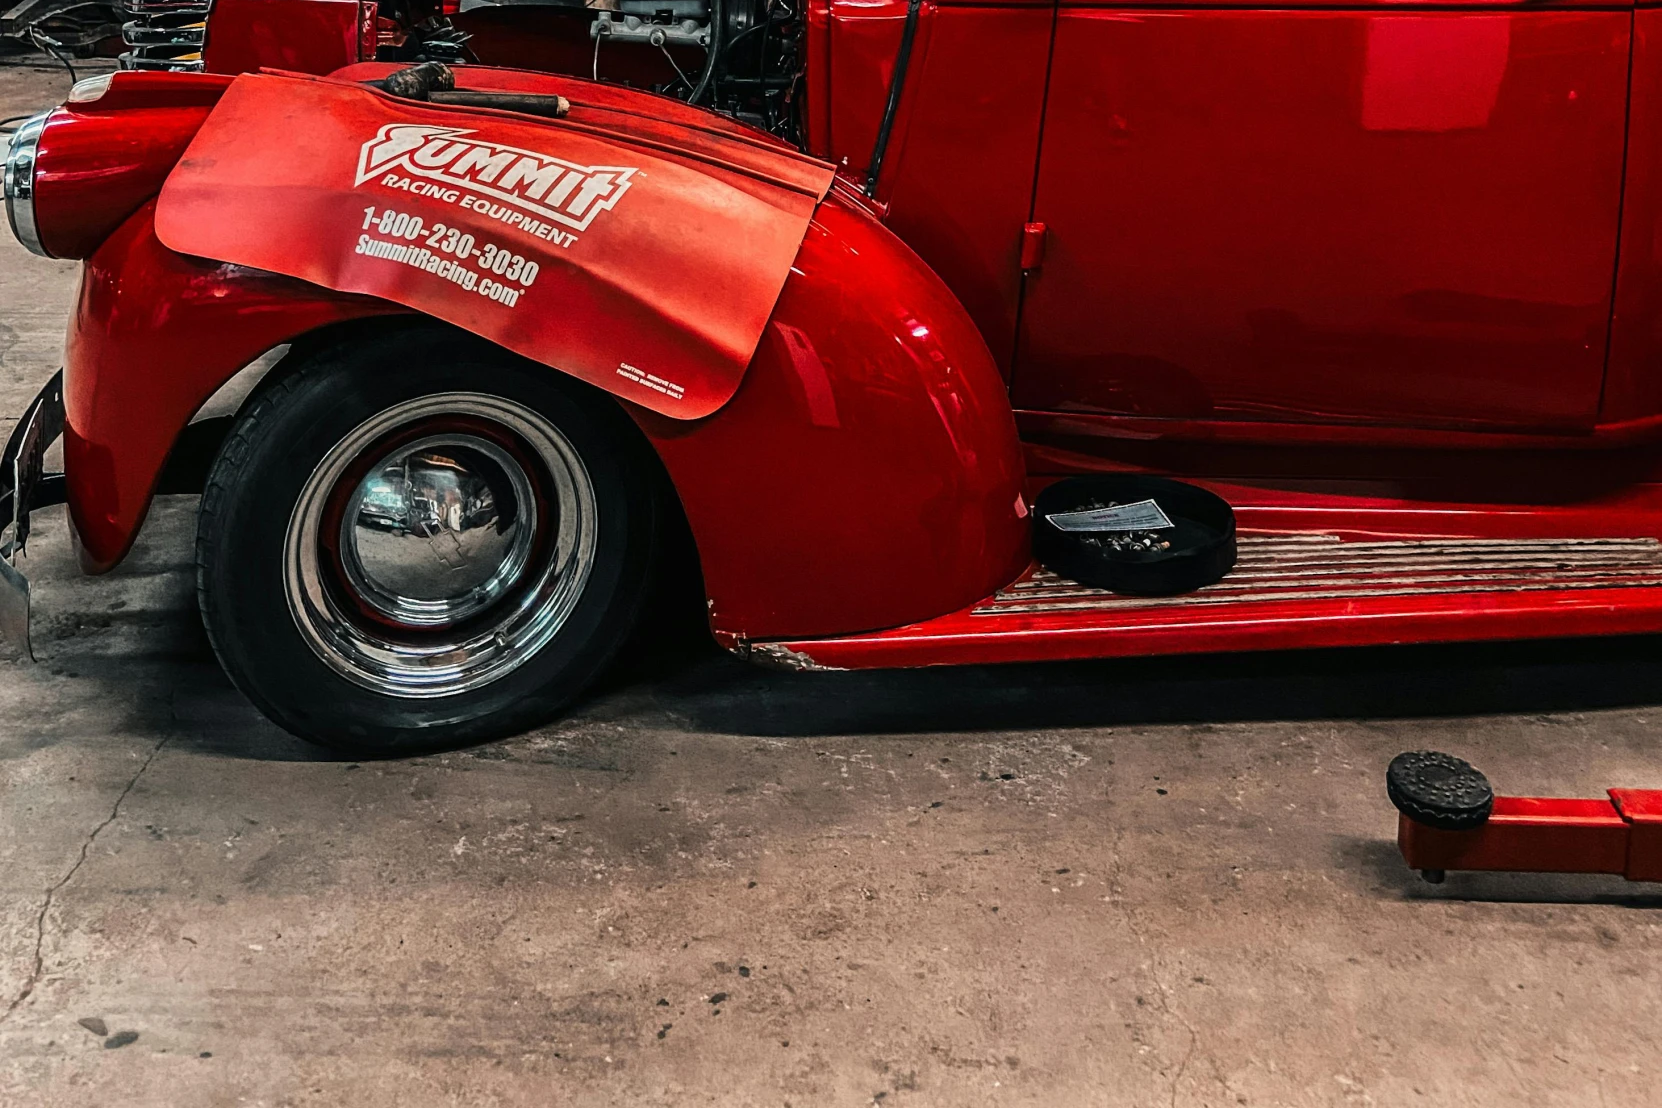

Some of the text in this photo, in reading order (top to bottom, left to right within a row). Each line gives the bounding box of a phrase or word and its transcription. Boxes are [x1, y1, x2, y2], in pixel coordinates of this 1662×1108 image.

[362, 206, 540, 287] 1-800-230-3030
[380, 173, 578, 249] RACING EQUIPMENT
